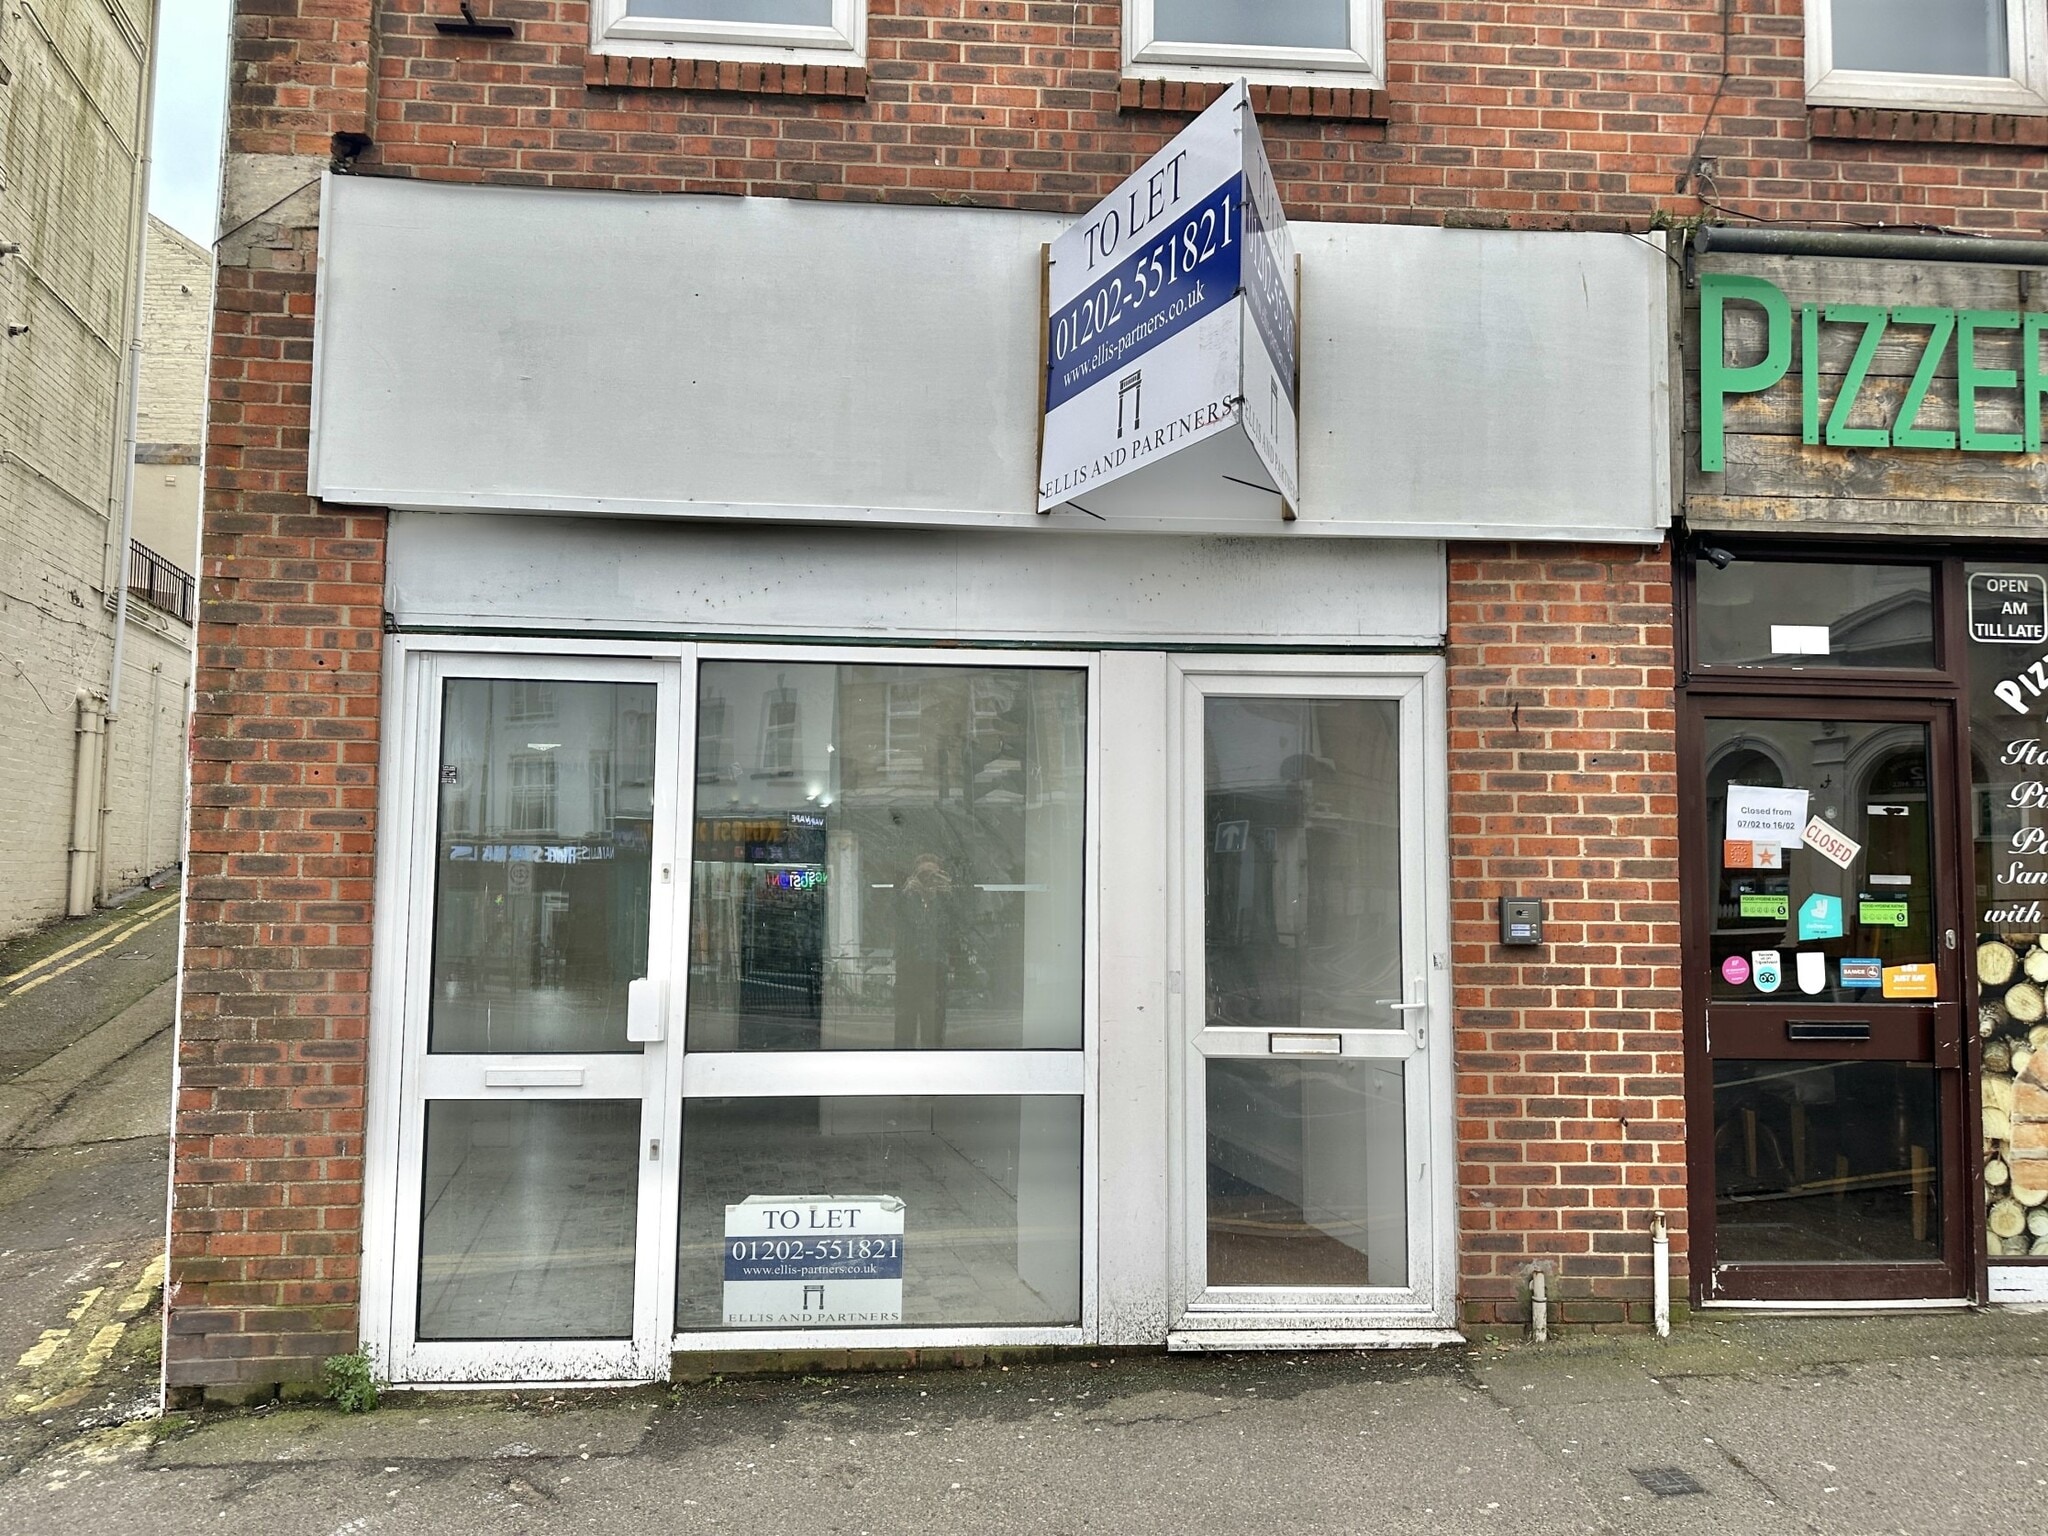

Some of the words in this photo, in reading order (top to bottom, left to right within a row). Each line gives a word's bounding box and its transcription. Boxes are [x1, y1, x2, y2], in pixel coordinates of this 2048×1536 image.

[1257, 149, 1270, 221] TO
[1084, 209, 1120, 271] TO
[1127, 150, 1187, 240] LET
[1056, 194, 1233, 361] 01202-551821
[1063, 279, 1206, 388] www.ellis-partners.co.uk
[1045, 465, 1088, 499] ELLIS
[1091, 447, 1127, 478] AND
[1132, 394, 1233, 460] PARTNERS
[1986, 579, 2029, 592] OPEN
[2001, 602, 2028, 615] AM
[1975, 623, 2005, 637] TILL
[2008, 624, 2043, 638] LATE
[1994, 654, 2048, 715] PIZ
[1741, 806, 1771, 816] Closed
[1772, 808, 1792, 816] from
[1737, 820, 1760, 829] 07/02
[1762, 821, 1771, 829] to
[1773, 821, 1795, 830] 16/02
[1806, 825, 1853, 863] CLOSED
[1983, 900, 2045, 924] with
[763, 1210, 800, 1229] TO
[809, 1209, 861, 1229] LET
[732, 1239, 898, 1261] 01202-551821
[743, 1263, 877, 1277] www.ellis-partners.co.uk
[729, 1314, 773, 1323] ELLIS
[778, 1313, 812, 1323] AND
[817, 1312, 900, 1323] PARTNERS
